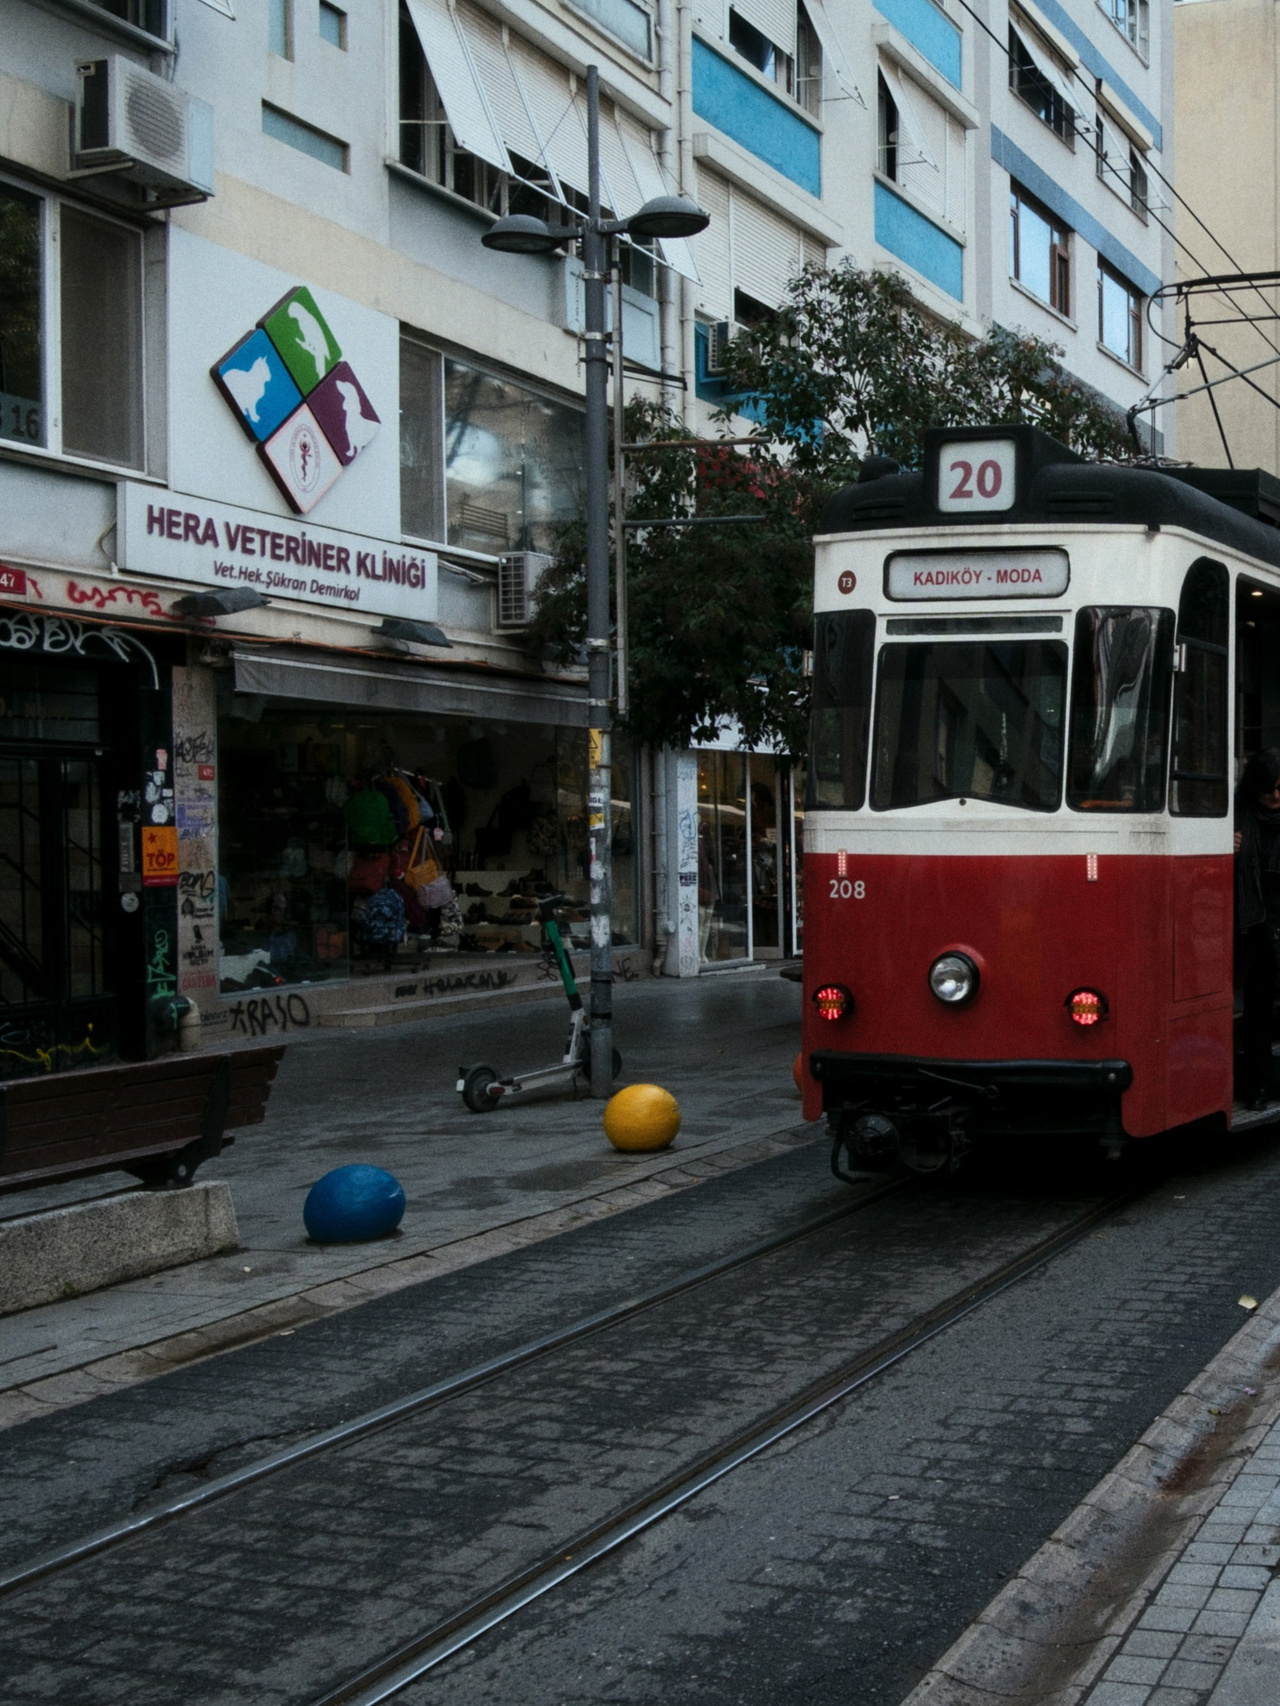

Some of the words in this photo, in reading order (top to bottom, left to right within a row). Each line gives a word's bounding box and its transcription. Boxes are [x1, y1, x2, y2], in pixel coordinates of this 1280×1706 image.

[948, 459, 1003, 500] 20
[147, 504, 219, 548] HERA
[224, 520, 352, 574] VETERİNER
[355, 548, 427, 590] KLİNİĞİ
[840, 577, 854, 589] T3
[913, 567, 984, 587] KADIKÖY
[995, 568, 1043, 585] MODA
[309, 578, 361, 602] Demirkol
[146, 849, 176, 868] TÖP
[828, 879, 867, 900] 208
